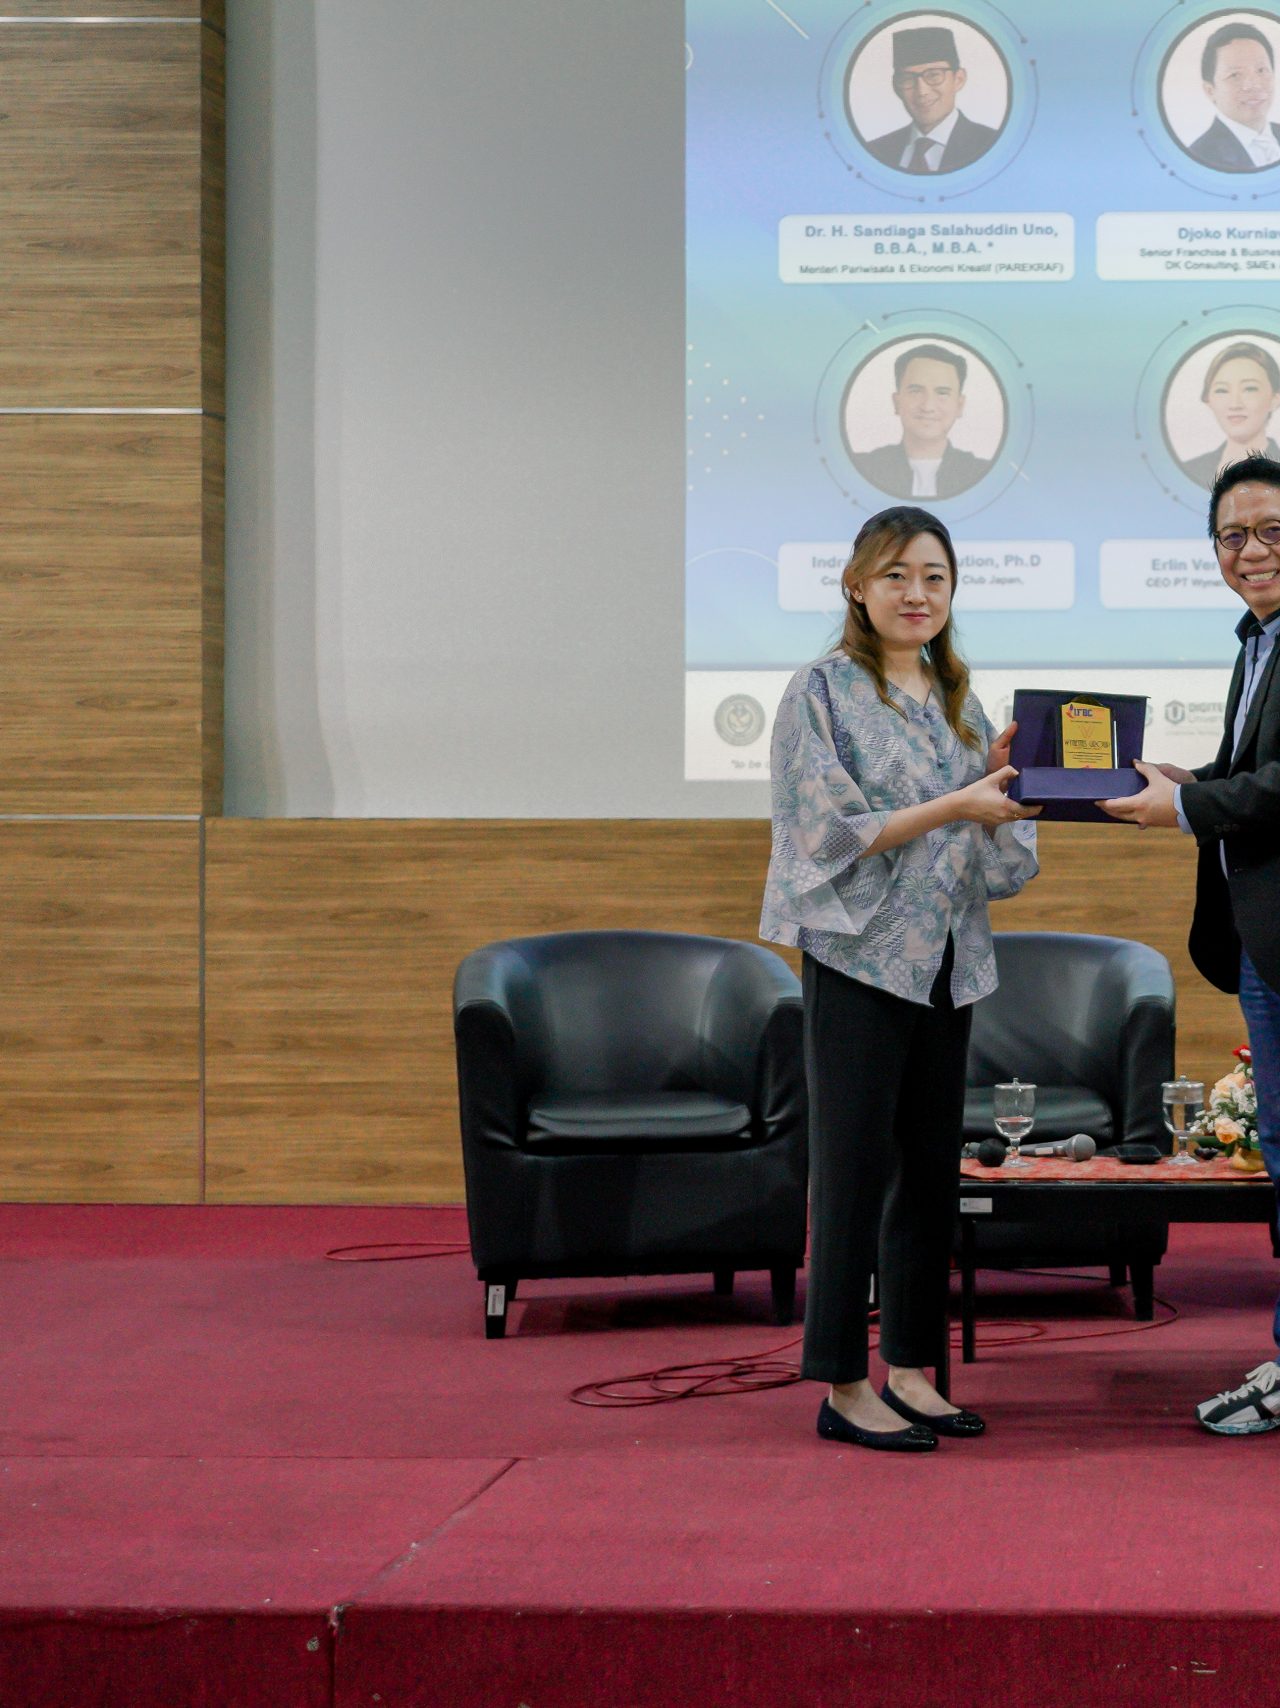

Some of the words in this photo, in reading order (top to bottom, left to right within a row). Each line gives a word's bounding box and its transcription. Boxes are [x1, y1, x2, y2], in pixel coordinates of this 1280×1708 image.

[805, 225, 826, 237] Dr.
[832, 225, 848, 237] H.
[854, 224, 926, 239] Sandiaga
[930, 223, 1018, 237] Salahuddin
[1023, 223, 1059, 238] Uno,
[1178, 227, 1221, 242] Djoko
[874, 243, 927, 256] B.B.A.,
[932, 242, 982, 254] M.B.A.
[1139, 248, 1173, 257] Senior
[1176, 248, 1227, 257] Franchise
[1230, 248, 1238, 257] &
[799, 264, 838, 274] Menteri
[841, 264, 895, 274] Pariwisata
[899, 264, 906, 273] &
[910, 264, 954, 273] Ekonomi
[958, 263, 992, 273] Kreatif
[995, 262, 1064, 274] (PAREKRAF)
[1165, 261, 1181, 270] DK
[812, 555, 852, 569] Indr
[1004, 554, 1041, 567] Ph.D
[1146, 577, 1172, 588] CEO
[1174, 577, 1188, 587] PT
